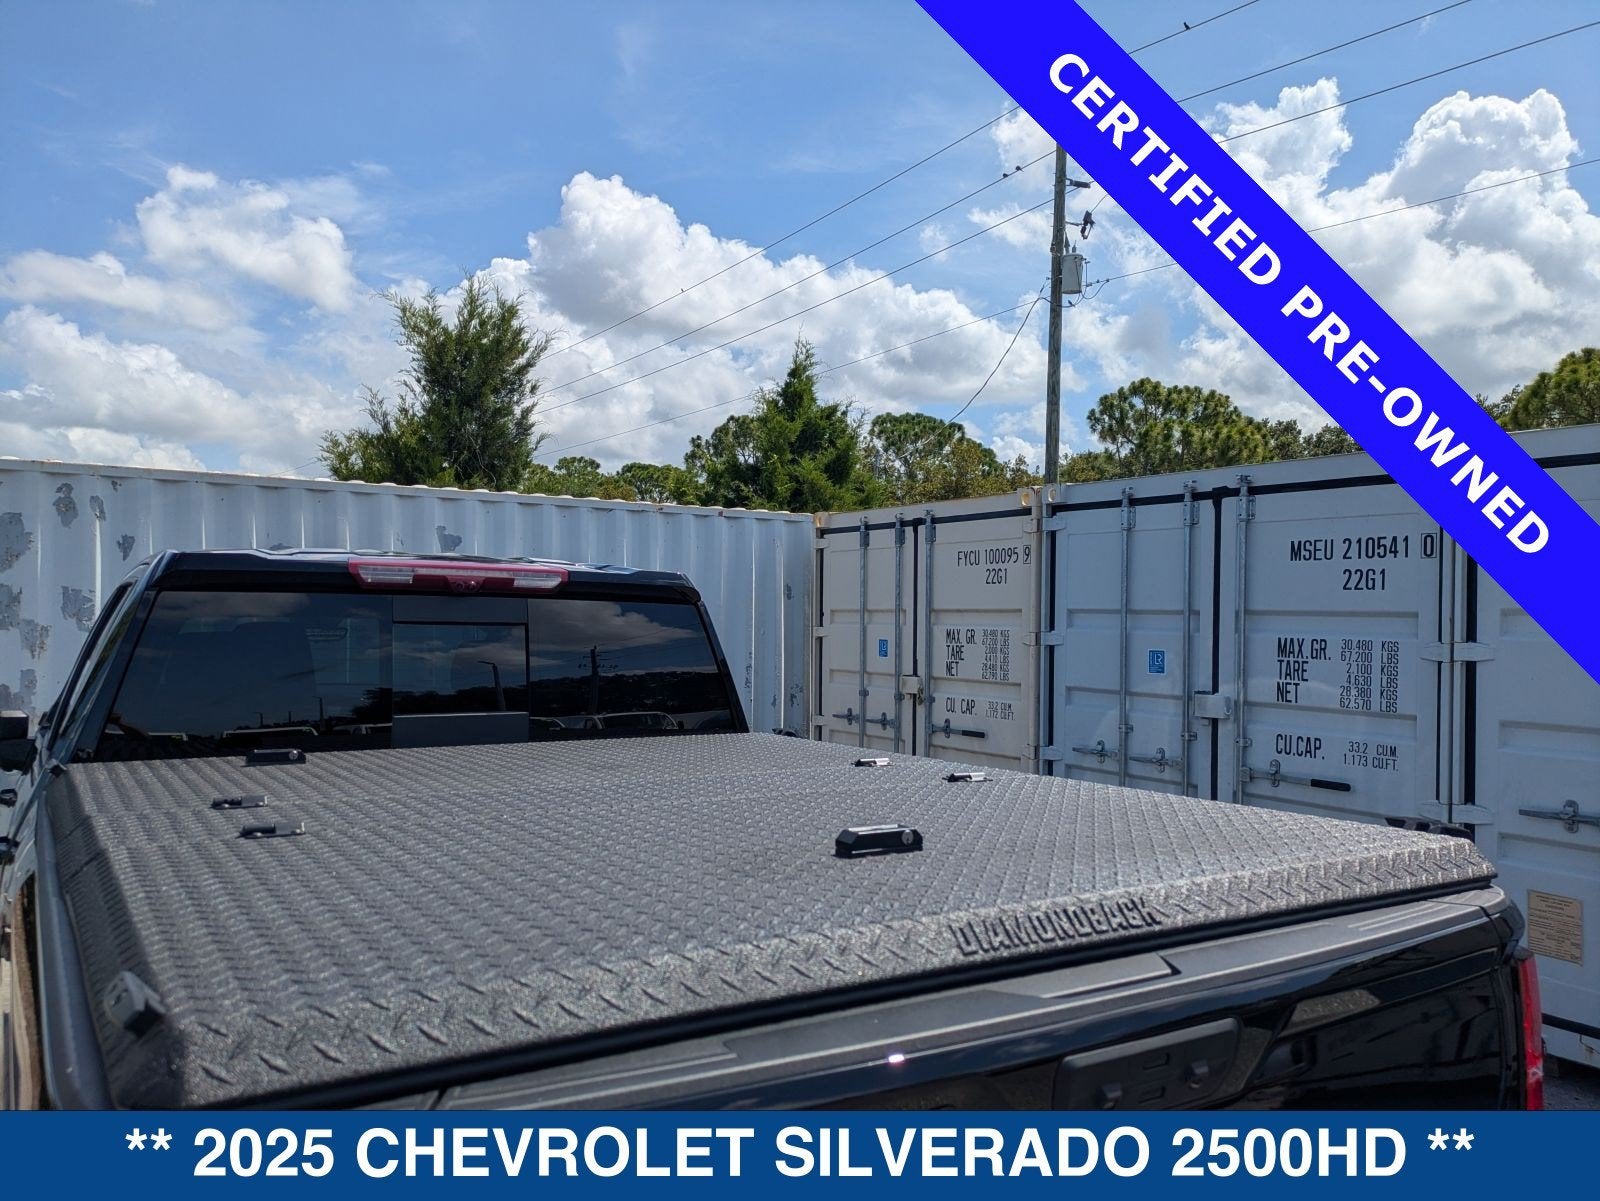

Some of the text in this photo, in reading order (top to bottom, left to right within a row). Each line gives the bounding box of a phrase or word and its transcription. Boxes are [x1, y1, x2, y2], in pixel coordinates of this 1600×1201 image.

[1290, 539, 1334, 561] MSEU
[1342, 535, 1409, 559] 210541
[957, 546, 1031, 567] FYCU 100095 9
[985, 568, 1008, 584] 22G1
[1342, 568, 1386, 590] 22G1
[946, 645, 964, 660] TARE
[1341, 639, 1373, 651] 30.480
[1381, 641, 1400, 653] KGS
[1340, 651, 1399, 665] 67.200 LBS
[945, 661, 960, 676] NET
[1277, 660, 1399, 682] TARE 2.100 KGS
[1345, 674, 1399, 689] 4.630 LBS
[1276, 682, 1398, 703] NET 28.380 KGS
[1339, 697, 1398, 713] 62.570 LBS
[1348, 741, 1368, 754] 33.2
[1344, 753, 1368, 767] 1.173
[948, 895, 1163, 957] DIAMONDBACK
